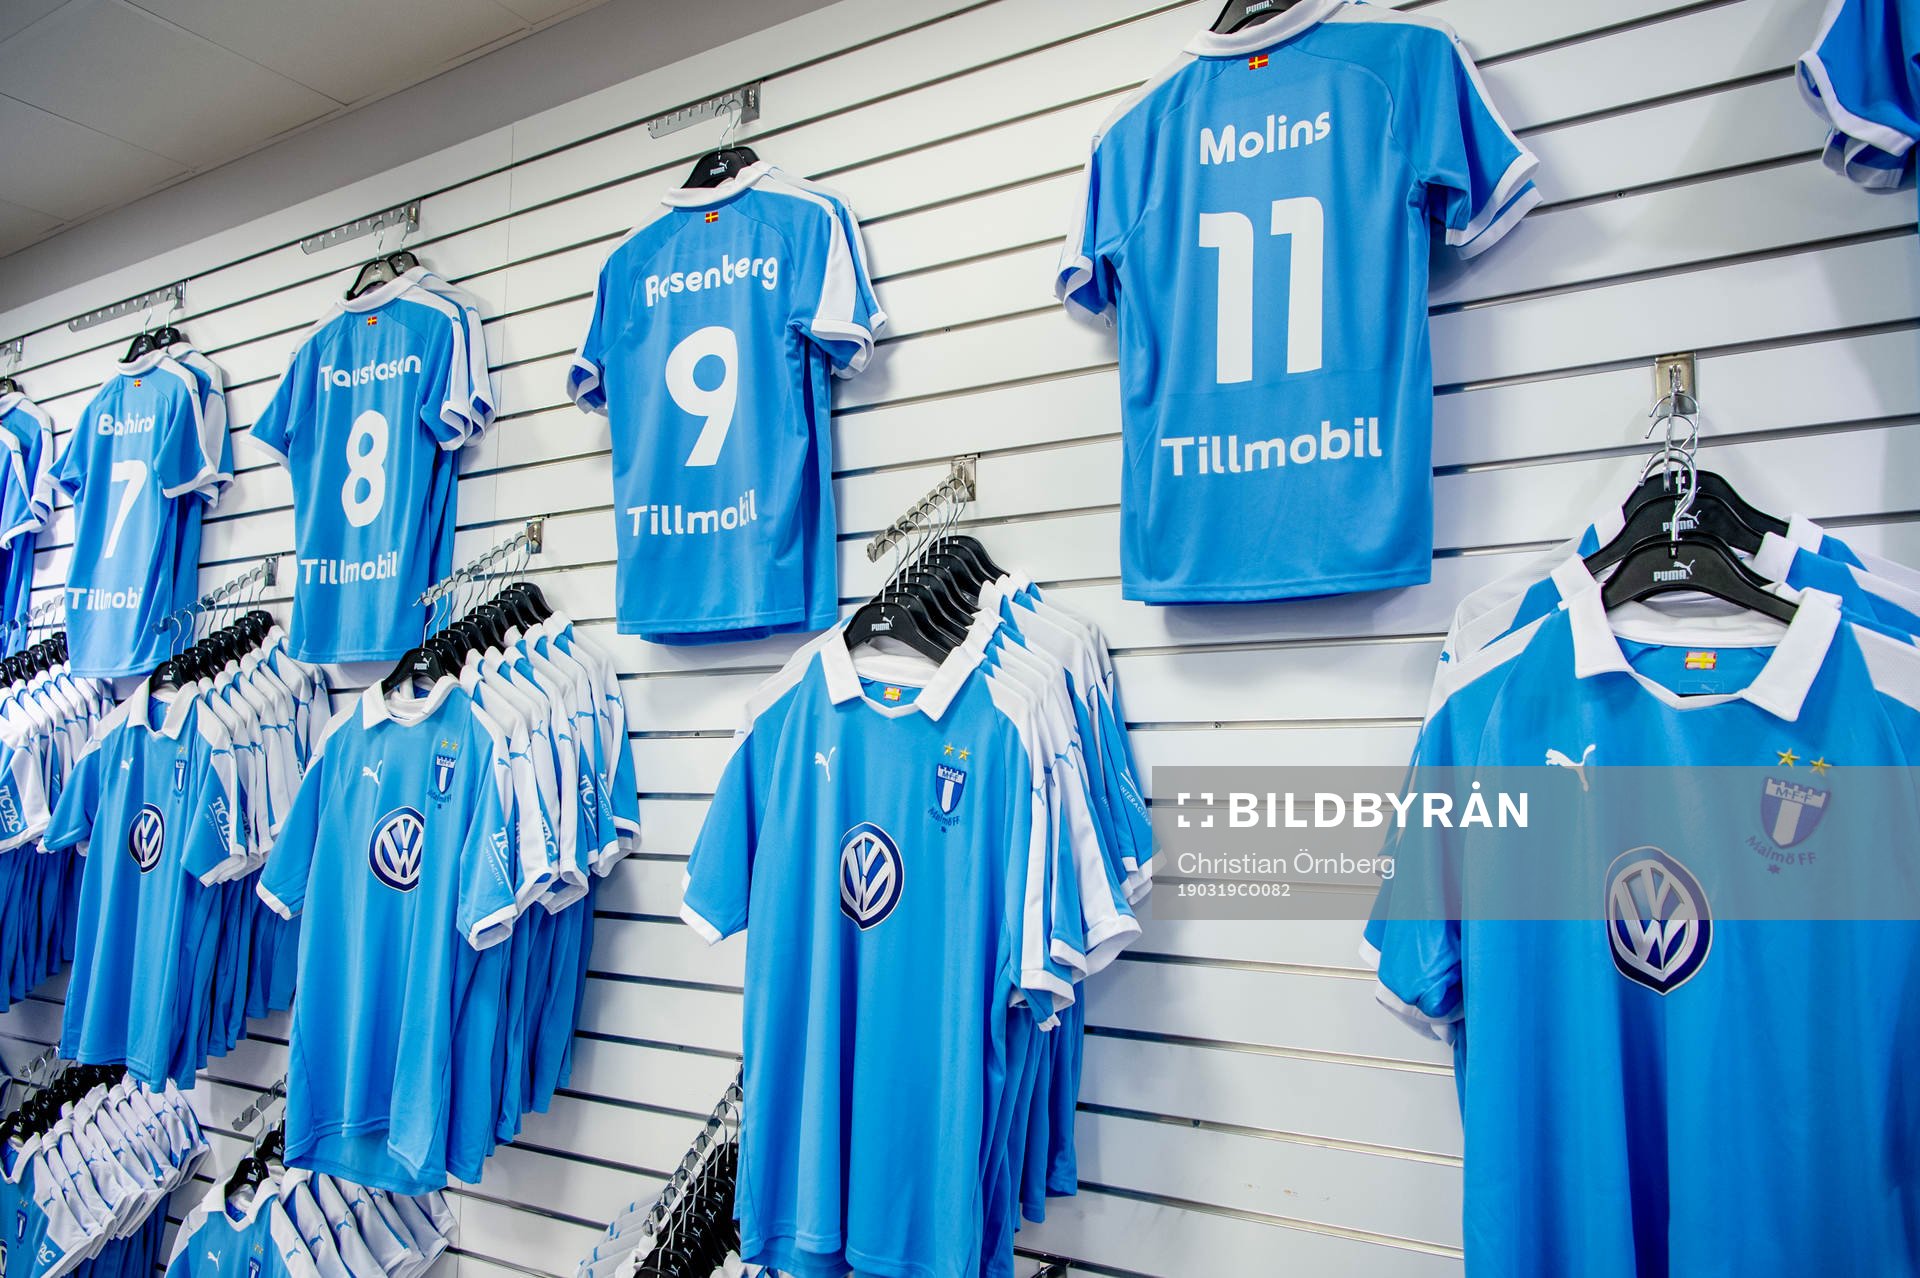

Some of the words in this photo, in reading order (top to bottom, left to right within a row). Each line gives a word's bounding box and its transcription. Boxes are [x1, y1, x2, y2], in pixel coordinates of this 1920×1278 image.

[1200, 111, 1331, 166] Molins
[645, 254, 778, 307] Rosenberg
[1199, 196, 1324, 384] 11
[665, 325, 739, 467] 9
[341, 409, 389, 528] 8
[1161, 416, 1383, 477] Tillmobil
[104, 459, 148, 559] 7
[1662, 519, 1697, 532] PMA
[300, 551, 398, 585] Tillmobil
[1653, 569, 1688, 582] PUMA
[1745, 835, 1795, 865] Malmö
[1797, 851, 1817, 866] FF
[1609, 859, 1699, 982] VW
